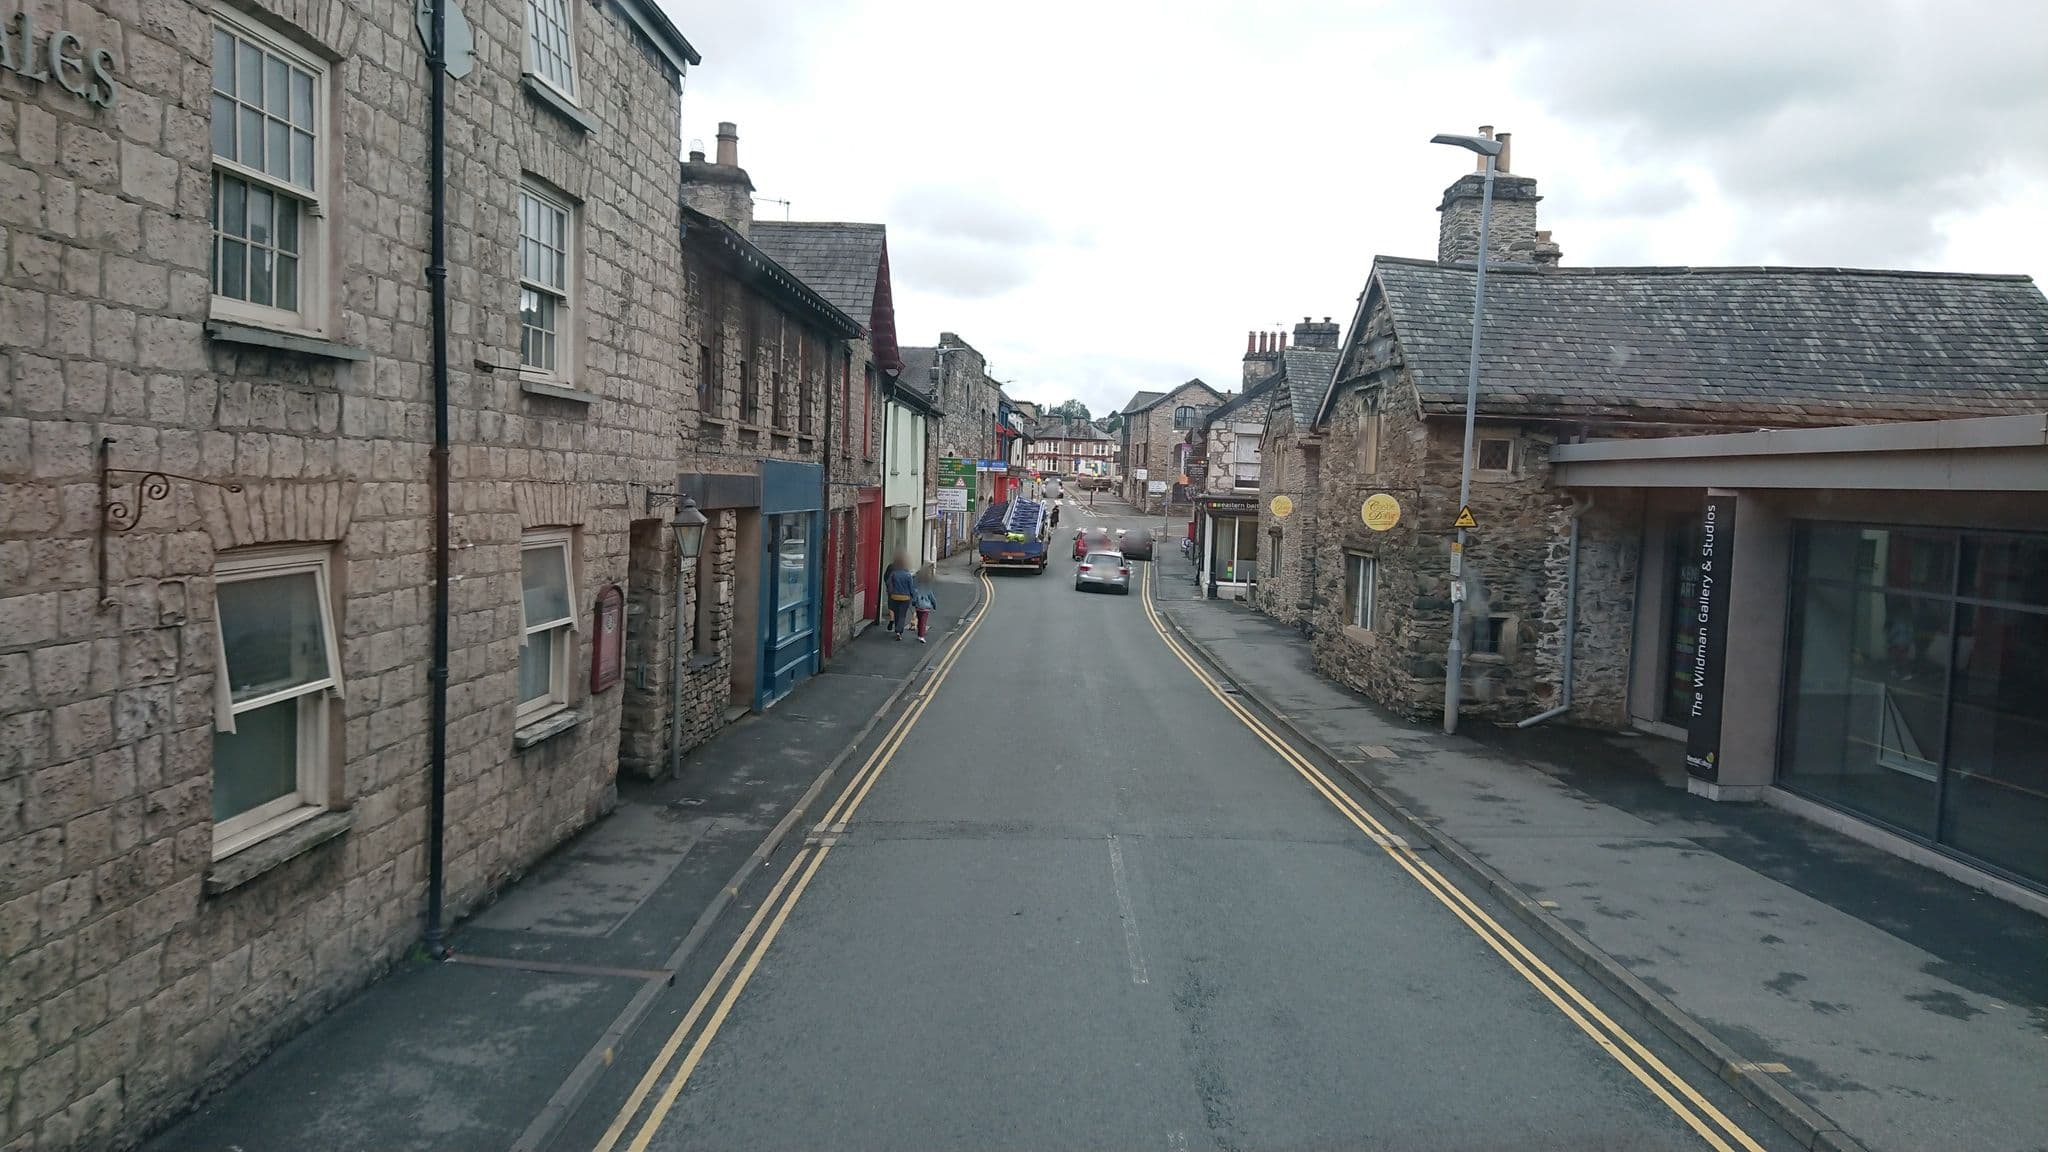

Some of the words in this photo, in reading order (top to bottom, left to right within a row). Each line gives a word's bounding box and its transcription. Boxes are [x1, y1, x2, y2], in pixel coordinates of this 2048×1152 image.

[1703, 505, 1716, 556] Studios
[1702, 561, 1712, 571] &
[1698, 575, 1713, 622] Gallery
[1694, 627, 1708, 688] Wildman
[1692, 692, 1703, 717] The
